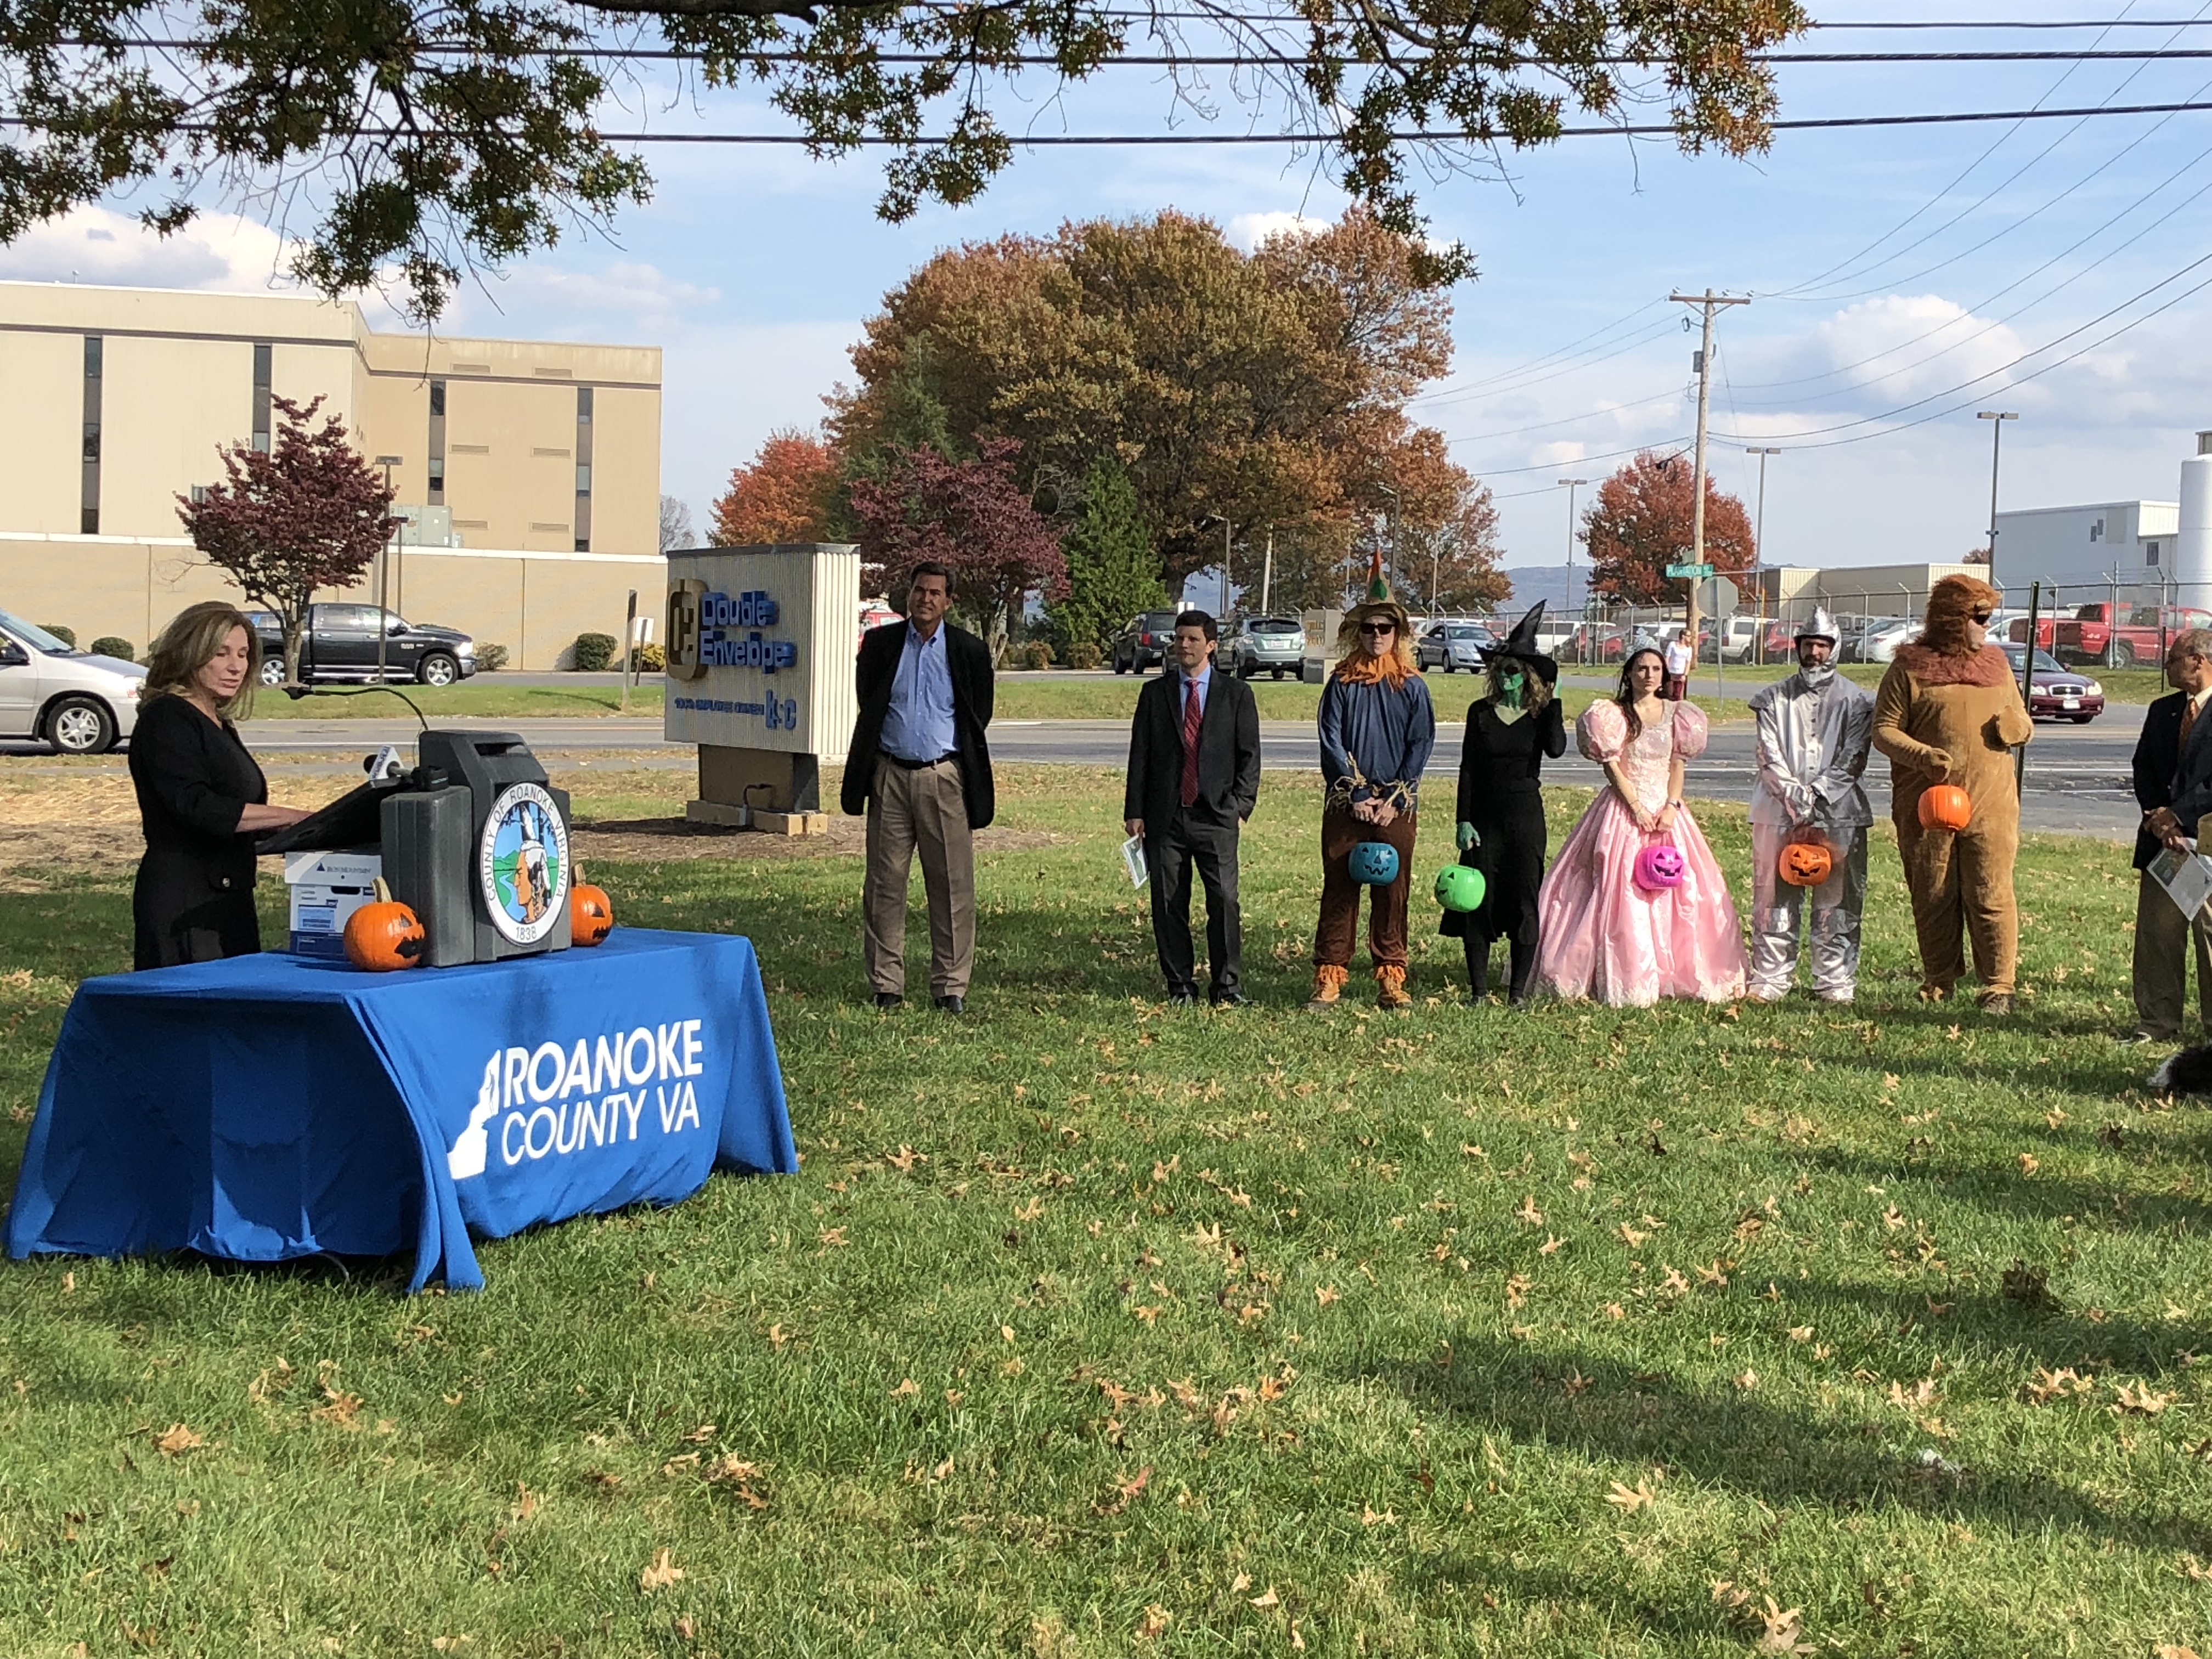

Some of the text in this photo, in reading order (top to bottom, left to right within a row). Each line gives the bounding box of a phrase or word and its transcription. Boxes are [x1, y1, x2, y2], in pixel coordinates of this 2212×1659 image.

[702, 591, 775, 626] Double
[484, 785, 567, 901] COUNTY OF ROANOKE VIRGINIA
[516, 926, 537, 940] 1838
[504, 1019, 703, 1108] ROANOKE
[501, 1081, 700, 1166] COUNTY VA
